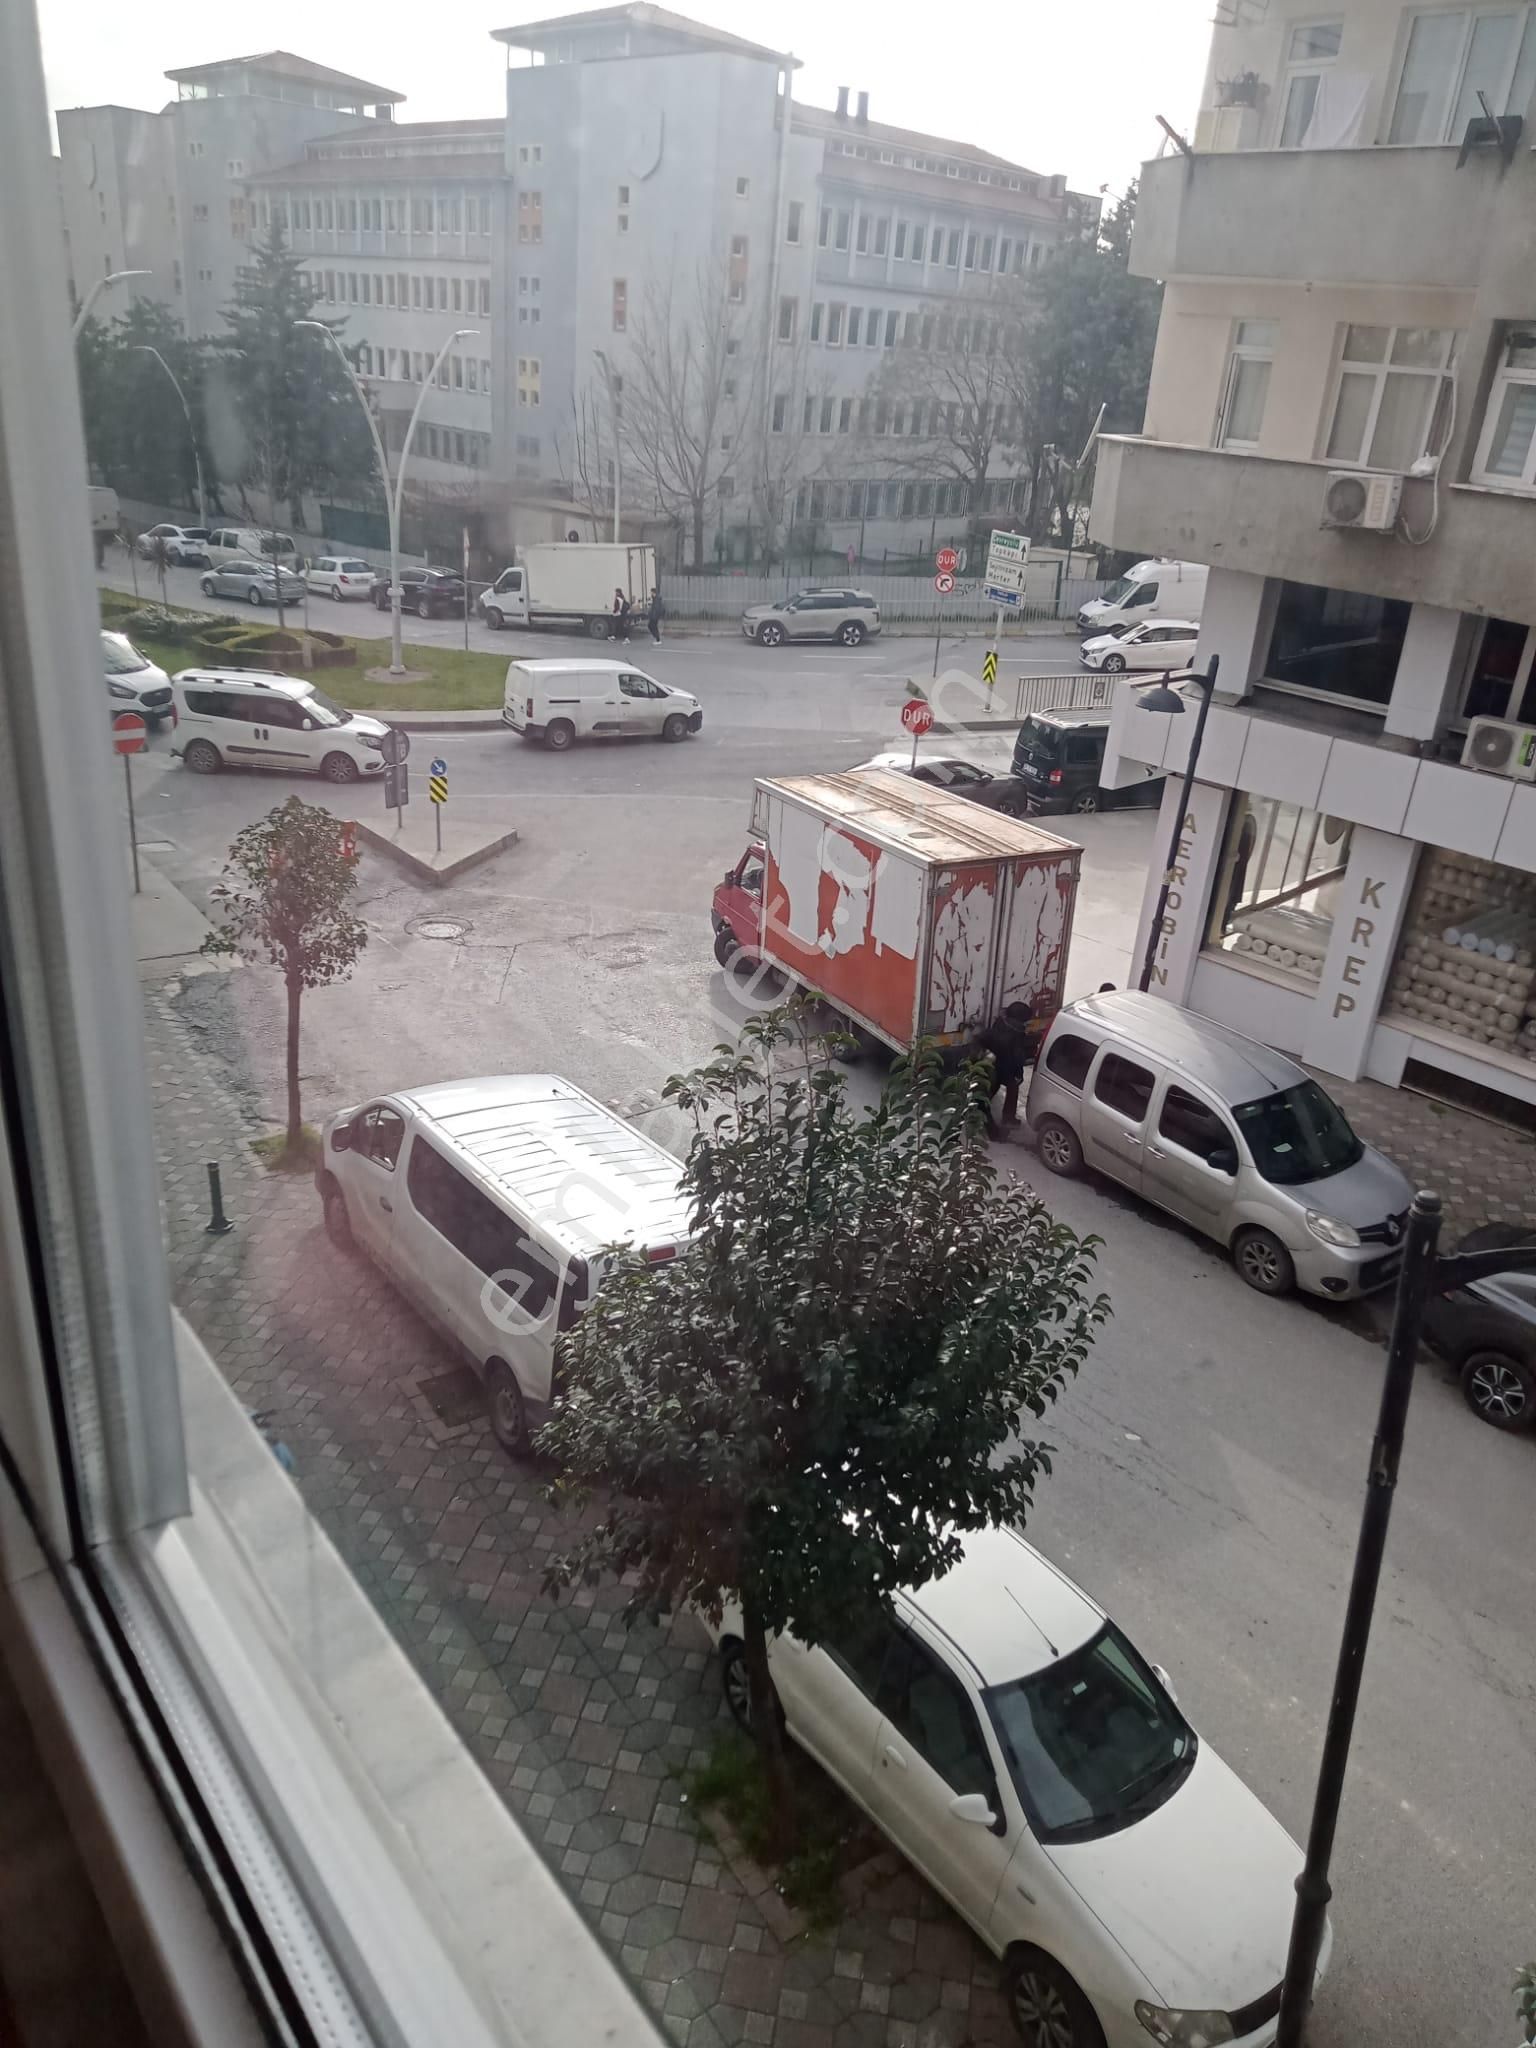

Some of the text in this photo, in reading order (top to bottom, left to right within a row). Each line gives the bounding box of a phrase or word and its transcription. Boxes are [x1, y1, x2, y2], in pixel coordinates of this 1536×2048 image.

[938, 554, 956, 565] DUR
[903, 709, 931, 726] DUR
[1332, 877, 1386, 1019] KREP
